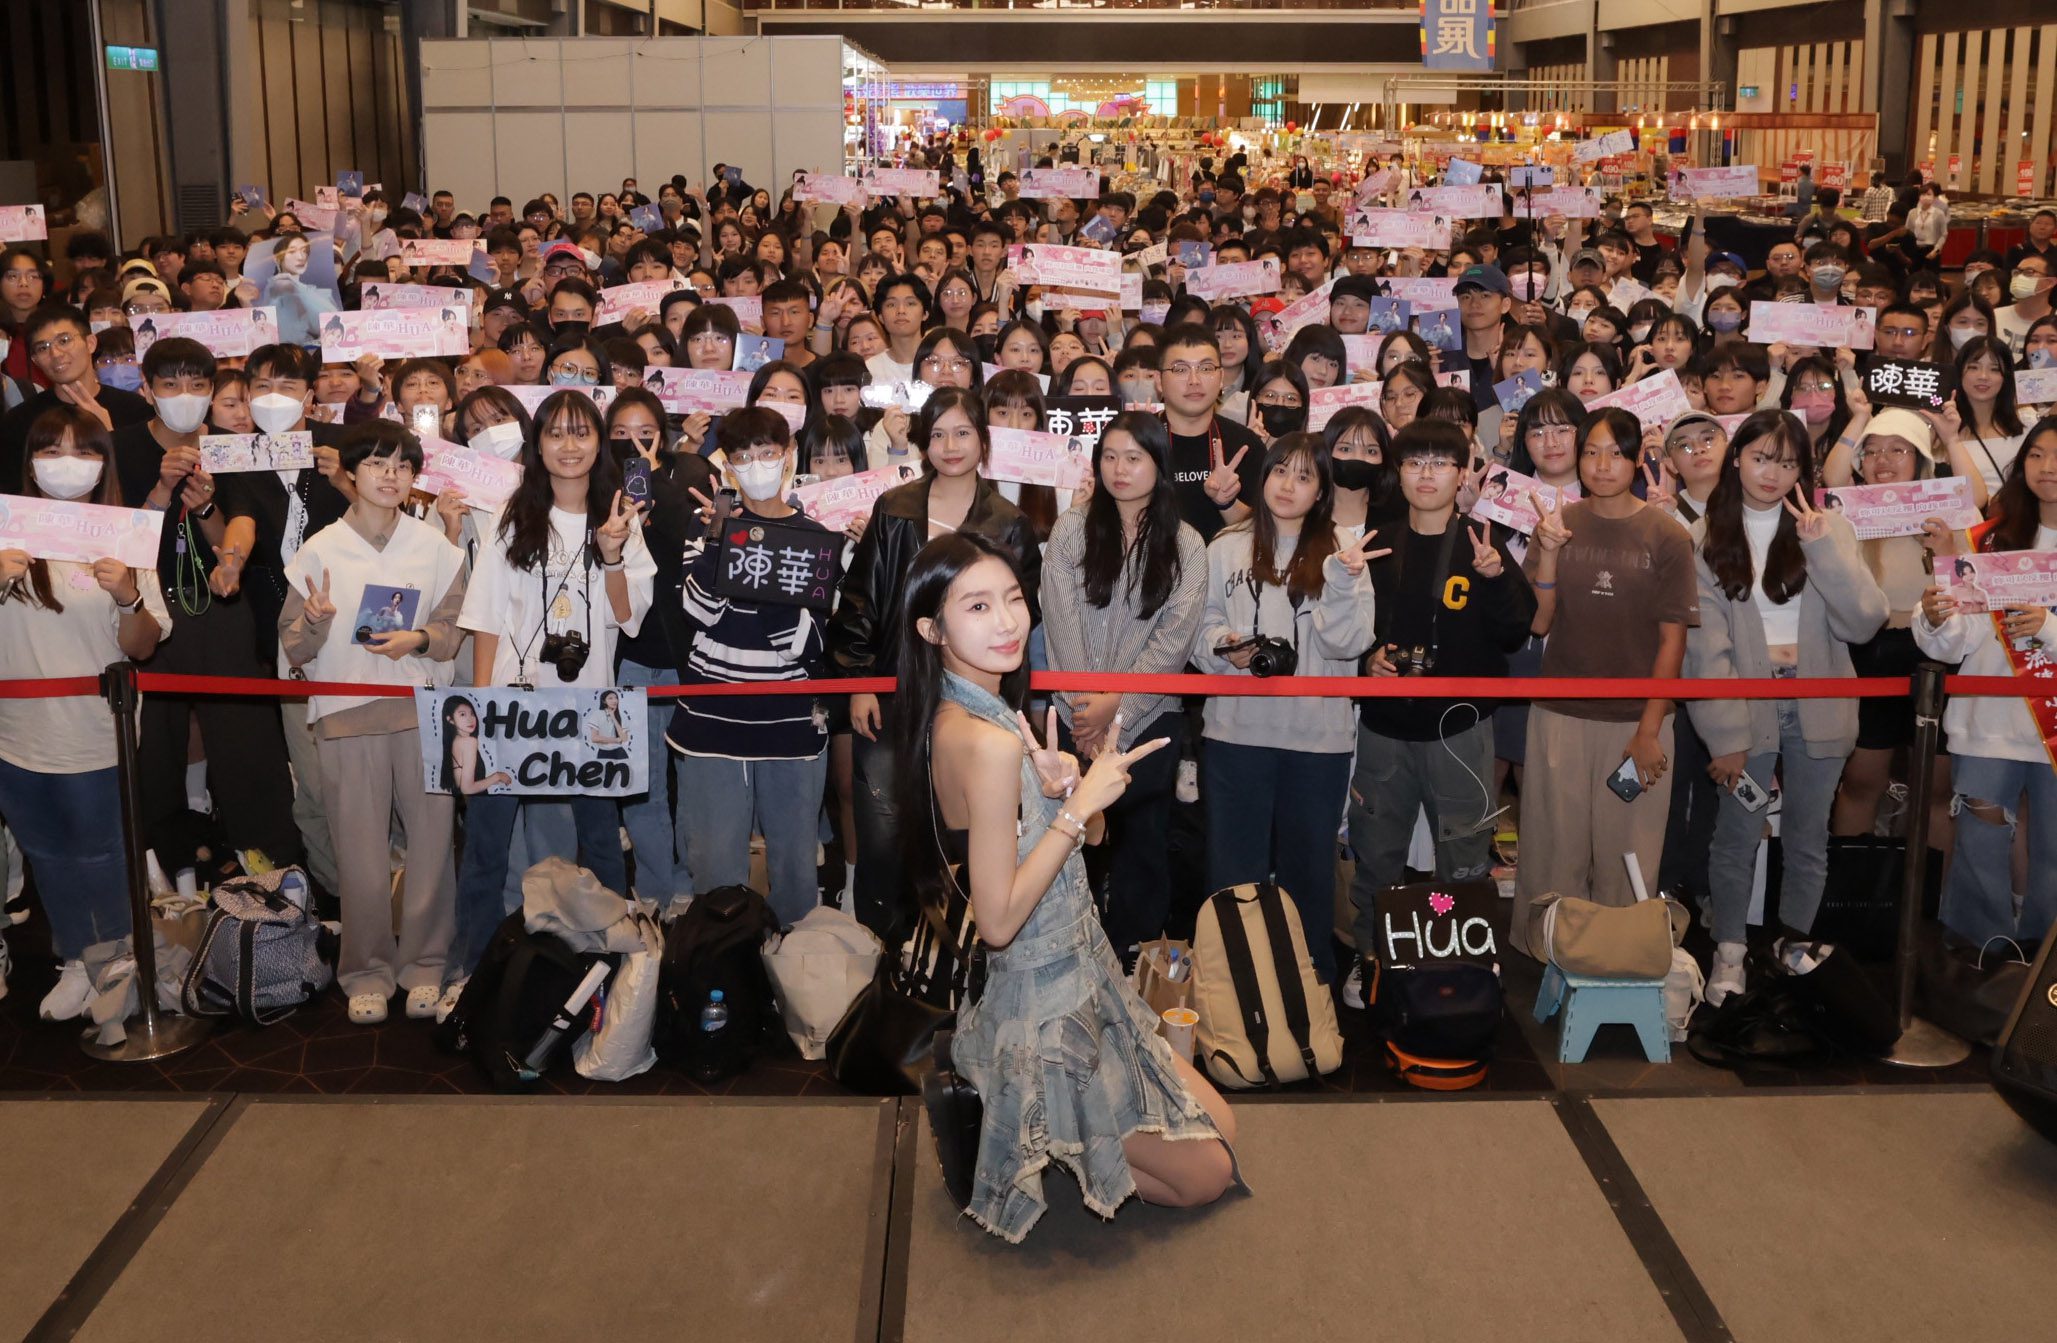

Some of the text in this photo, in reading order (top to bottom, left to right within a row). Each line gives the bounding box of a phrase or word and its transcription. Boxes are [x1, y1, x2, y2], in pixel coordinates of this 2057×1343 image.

[210, 324, 242, 337] HUA
[399, 319, 431, 336] HUA
[713, 383, 743, 396] HUA
[1871, 363, 1940, 399] 陳華
[1021, 445, 1056, 462] HUA
[76, 519, 116, 538] HUA
[728, 544, 815, 596] 陳華
[812, 547, 832, 600] HUA
[1443, 576, 1470, 610] C
[483, 700, 579, 739] Hua
[518, 750, 630, 789] Chen
[1385, 911, 1497, 960] Hua
